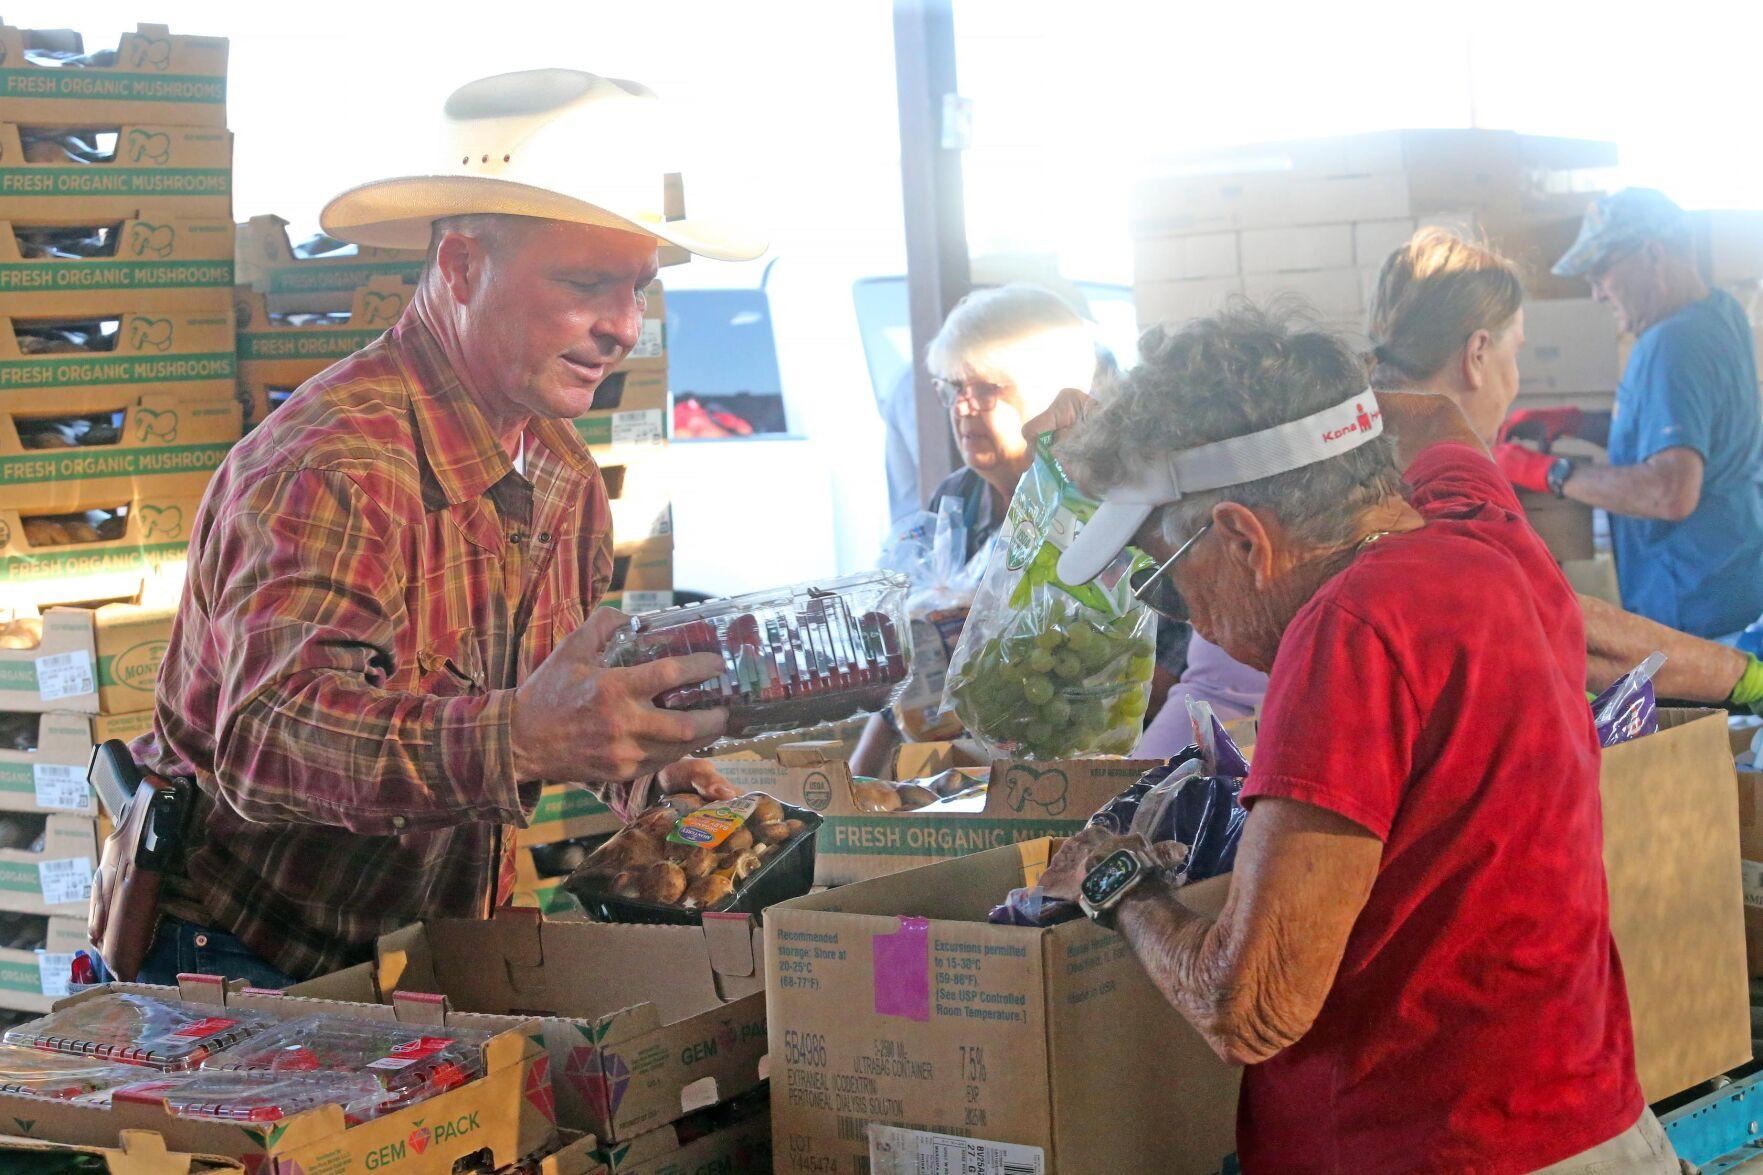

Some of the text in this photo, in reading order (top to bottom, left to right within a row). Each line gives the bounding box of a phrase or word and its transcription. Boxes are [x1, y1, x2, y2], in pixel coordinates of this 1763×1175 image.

[8, 76, 223, 98] FRESH ORGANIC MUSHROOMS
[3, 174, 226, 191] FRESH ORGANIC MUSHROOMS
[1, 267, 230, 286] FRESH ORGANIC MUSHROOMS
[252, 338, 295, 355] FRESH
[299, 337, 360, 353] ORGANIC
[1, 359, 231, 384] FRESH ORGANIC MUSHROOMS
[1322, 422, 1357, 443] Kona
[4, 449, 227, 478] FRESH ORGANIC MUSHROOM
[9, 561, 62, 578] FRESH
[66, 552, 140, 576] ORGANIC
[0, 670, 33, 682] RGANIC
[125, 663, 158, 680] MONT
[0, 771, 32, 784] RGANIC
[809, 781, 825, 790] USDA
[835, 826, 899, 848] FRESH
[907, 828, 1004, 849] ORGANIC
[778, 928, 838, 944] Recommended
[815, 947, 836, 960] Store
[839, 949, 846, 961] at
[935, 939, 1026, 957] Excursions permitted
[935, 956, 943, 969] to
[959, 989, 977, 1002] USP
[980, 991, 1026, 1006] Controlled
[936, 1003, 962, 1017] Room
[681, 1038, 717, 1066] GEM
[785, 1029, 827, 1067] 5B4986
[893, 1059, 934, 1080] CONTAINER
[870, 1096, 904, 1119] SOLUTION
[365, 1140, 407, 1170] GEM
[434, 1111, 480, 1145] PACK
